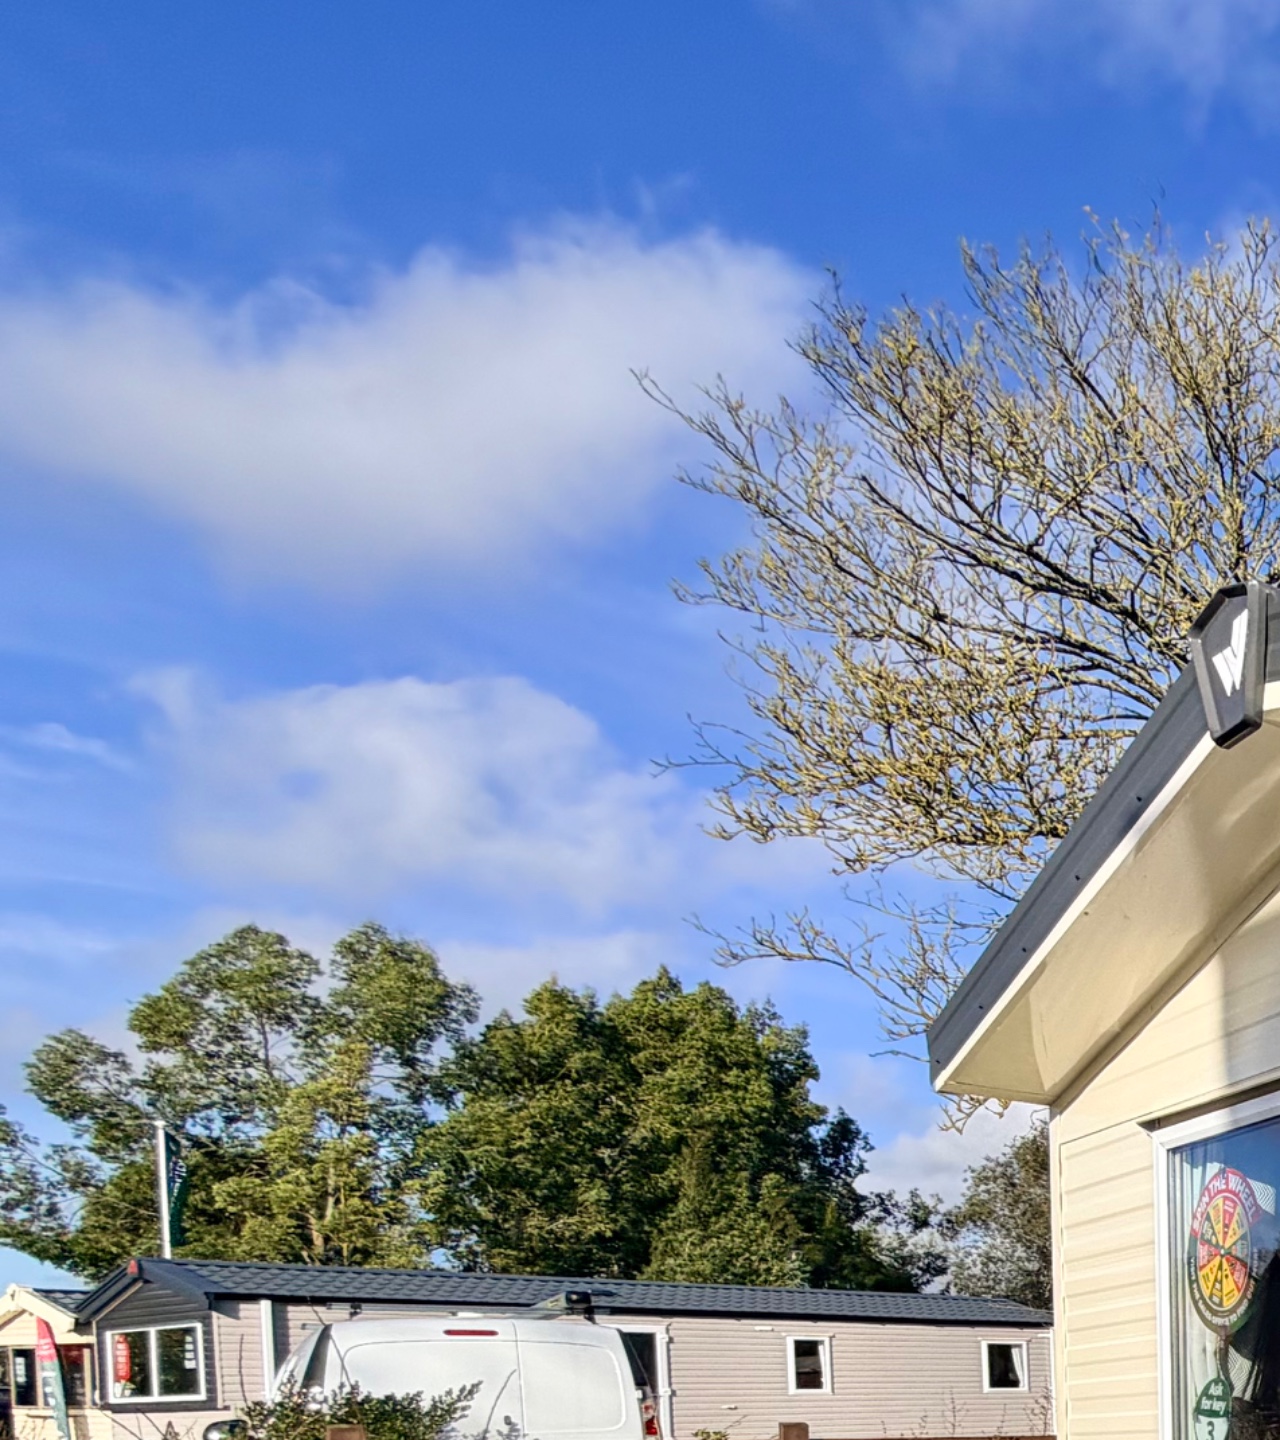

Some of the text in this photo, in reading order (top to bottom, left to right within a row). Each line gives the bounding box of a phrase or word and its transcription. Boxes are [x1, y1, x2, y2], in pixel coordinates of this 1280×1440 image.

[1192, 1172, 1257, 1231] SPIN THE WHEEL
[1208, 1382, 1224, 1397] Ask
[1201, 1396, 1227, 1416] for key
